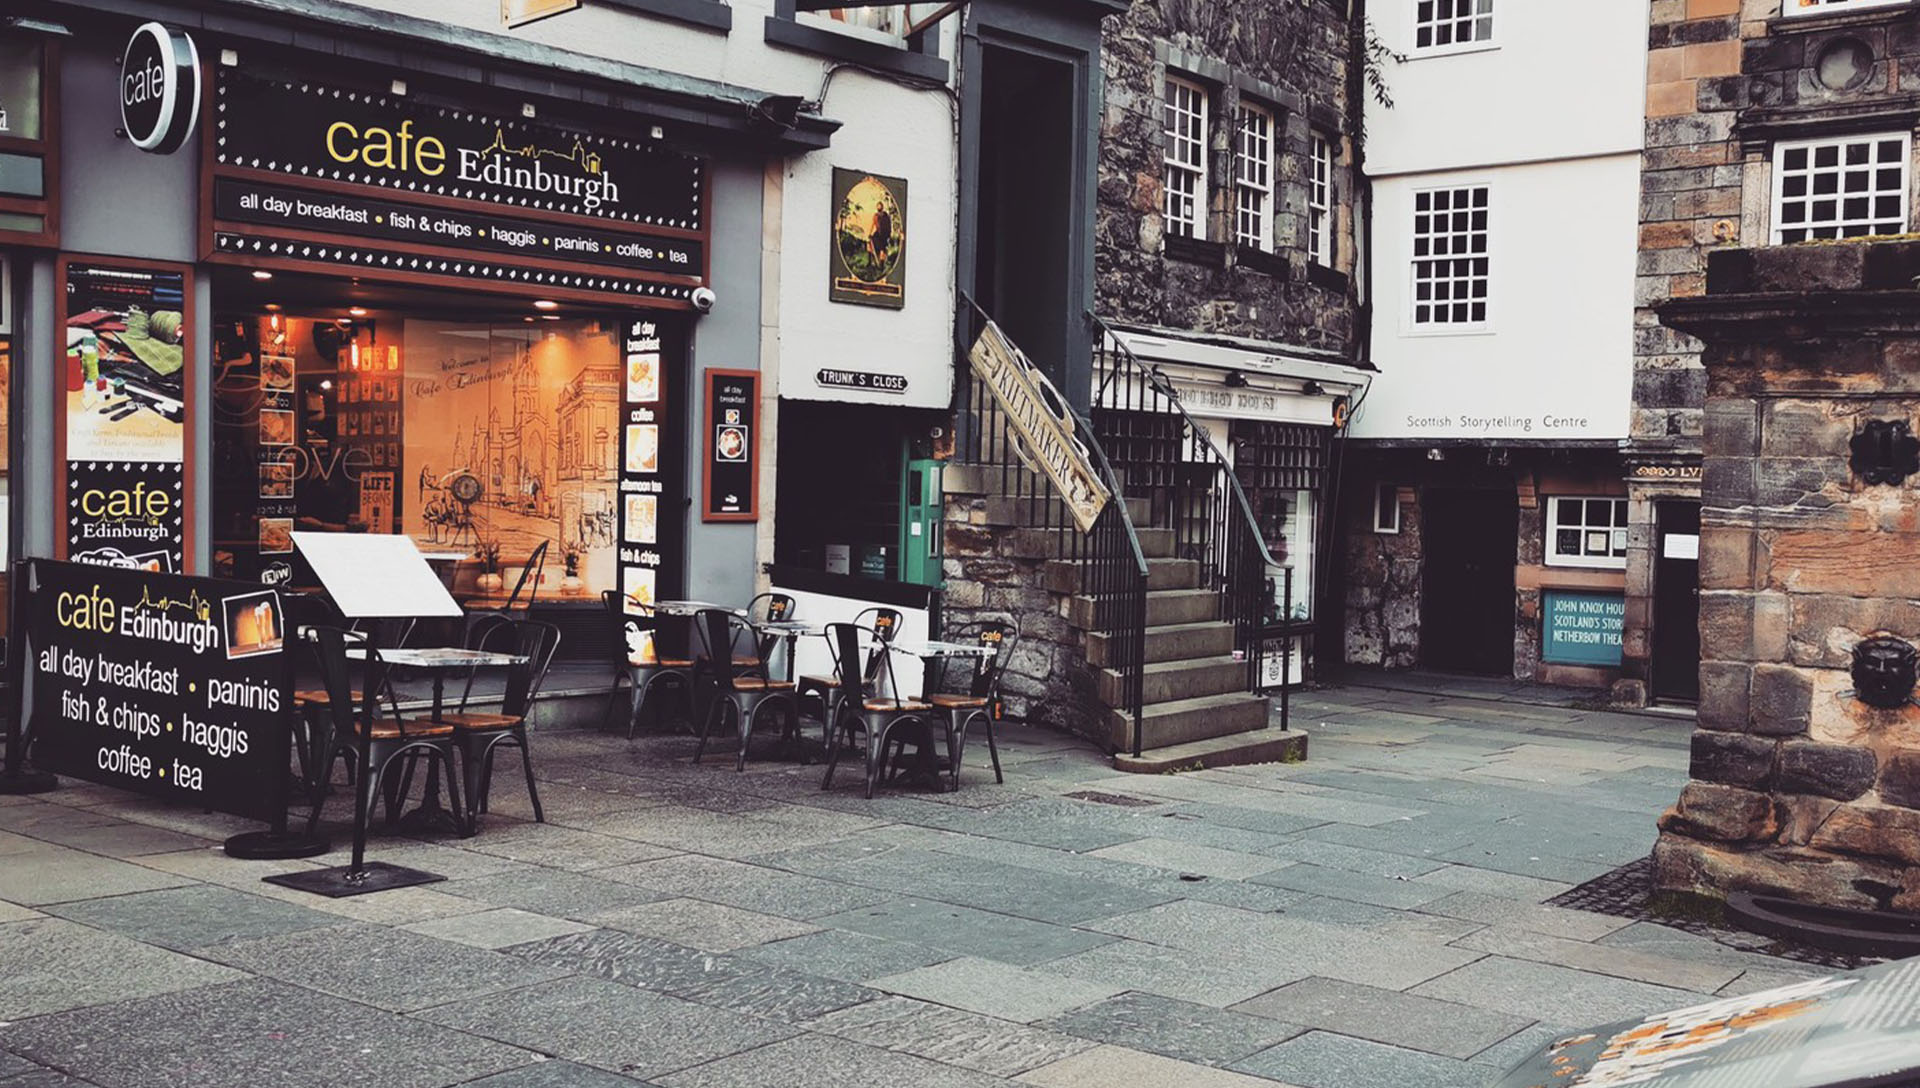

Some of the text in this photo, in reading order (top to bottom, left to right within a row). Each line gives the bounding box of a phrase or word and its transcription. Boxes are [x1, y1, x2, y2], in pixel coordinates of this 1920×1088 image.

[124, 56, 164, 106] cafe
[326, 120, 620, 207] cafe Edinburgh
[239, 193, 688, 263] all day breakfast fish & chips haggis paninis coffee tea
[445, 362, 514, 391] Edinburgh
[822, 370, 903, 389] TRUNK'S CLOSE
[1407, 414, 1588, 432] Scottish Storytelling Centre
[363, 477, 392, 491] LIFE
[81, 481, 169, 517] cafe
[361, 491, 392, 506] BEGINS
[83, 523, 169, 541] Edinburgh
[640, 550, 660, 567] chips
[57, 584, 219, 654] cafe Edinburgh
[1554, 600, 1624, 615] JOHN KNOX HOU
[1554, 614, 1600, 628] SCOTLAND'S
[1553, 629, 1623, 646] NETHERBOW THEA
[40, 645, 280, 712] all day breakfast paninis
[62, 690, 249, 758] fish & chips haggis
[98, 745, 203, 790] coffee tea
